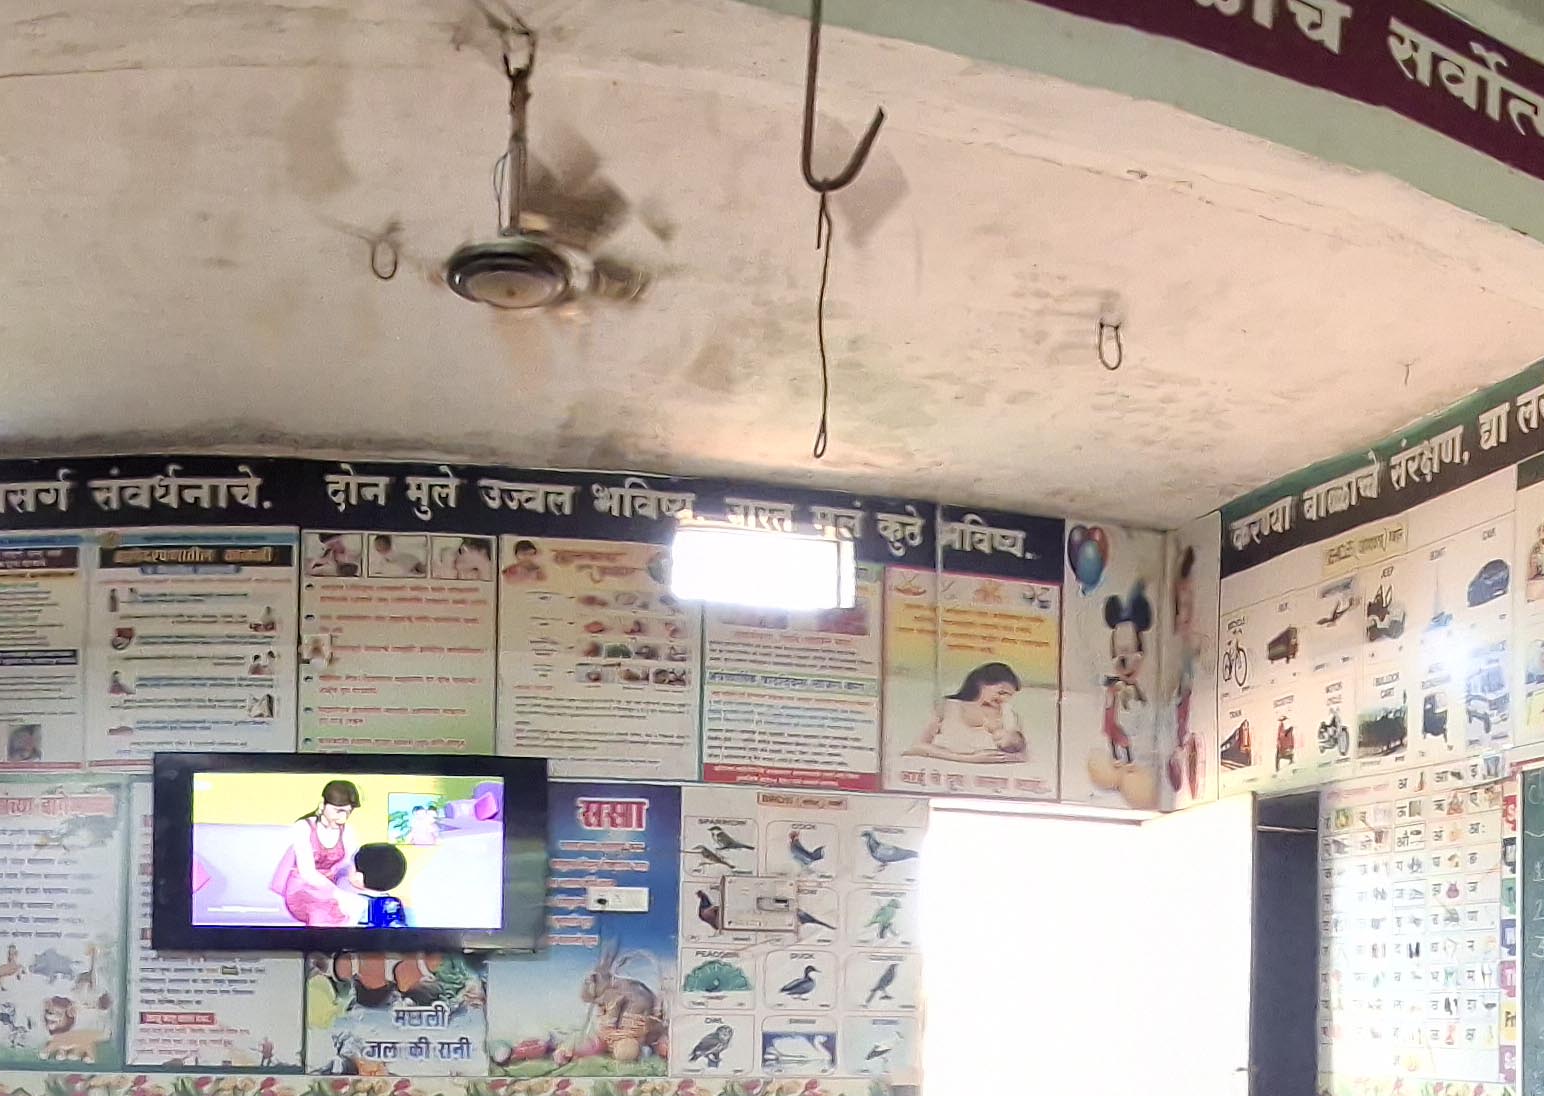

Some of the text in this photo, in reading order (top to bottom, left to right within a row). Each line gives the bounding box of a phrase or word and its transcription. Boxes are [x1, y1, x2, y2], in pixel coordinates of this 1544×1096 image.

[1478, 399, 1510, 450] द्या
[325, 473, 387, 510] दोन
[406, 466, 460, 516] मुले
[479, 480, 573, 520] उज्वल
